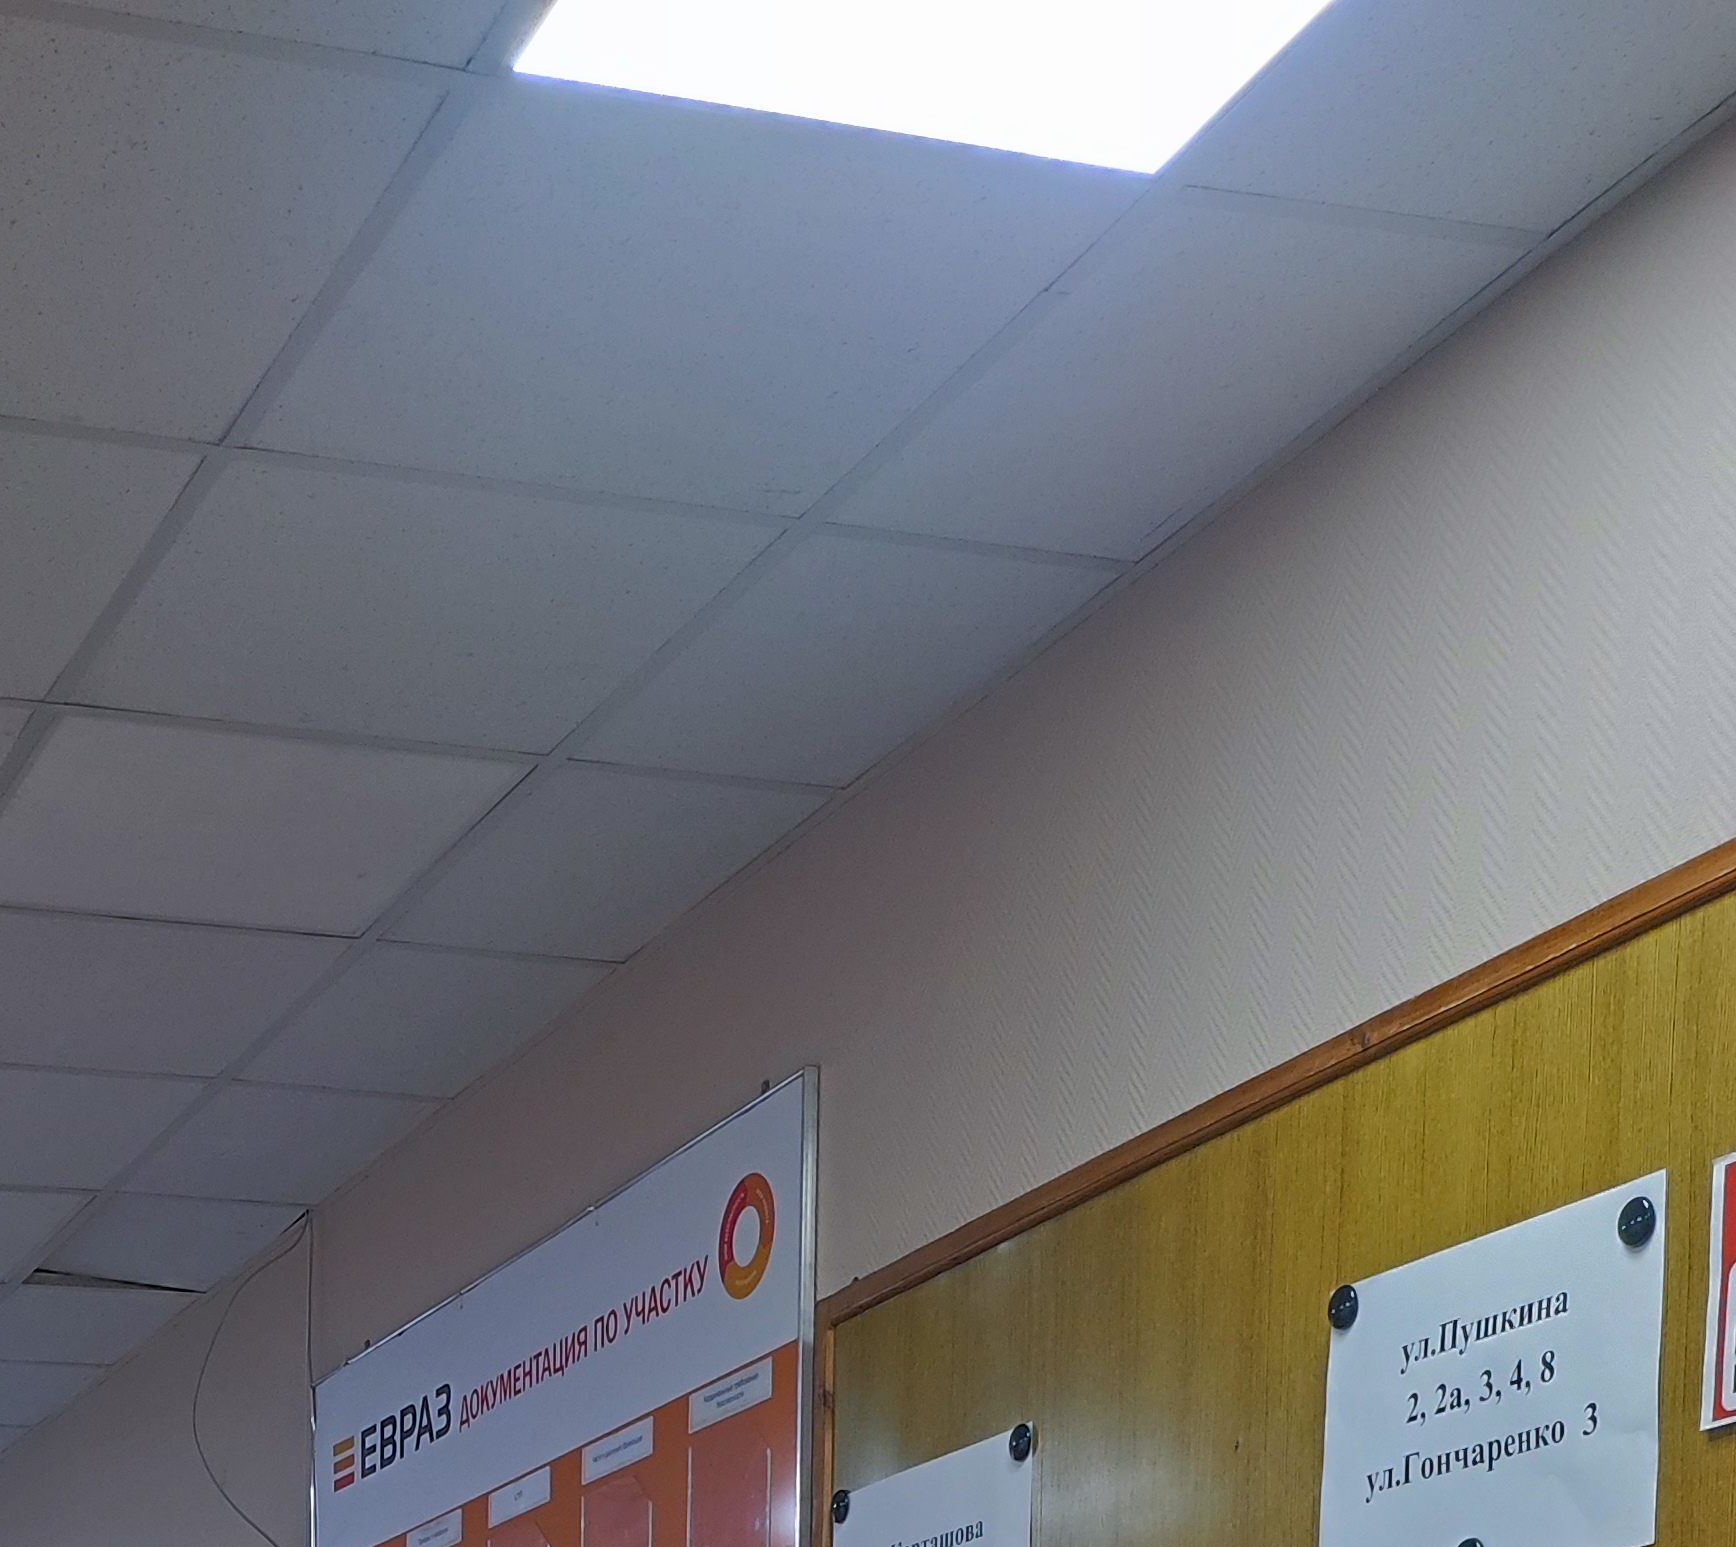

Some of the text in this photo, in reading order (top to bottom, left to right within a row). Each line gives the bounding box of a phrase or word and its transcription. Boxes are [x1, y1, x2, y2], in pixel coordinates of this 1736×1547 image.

[360, 1254, 709, 1480] ЕВРАЗ ДОКУМЕНТАЦИЯ ПО УЧАСТКУ
[1399, 1289, 1570, 1375] ул.Пушкина
[1405, 1349, 1556, 1426] 2, 2а, 3, 4, 8
[1365, 1401, 1599, 1504] ул.Гончаренко 3
